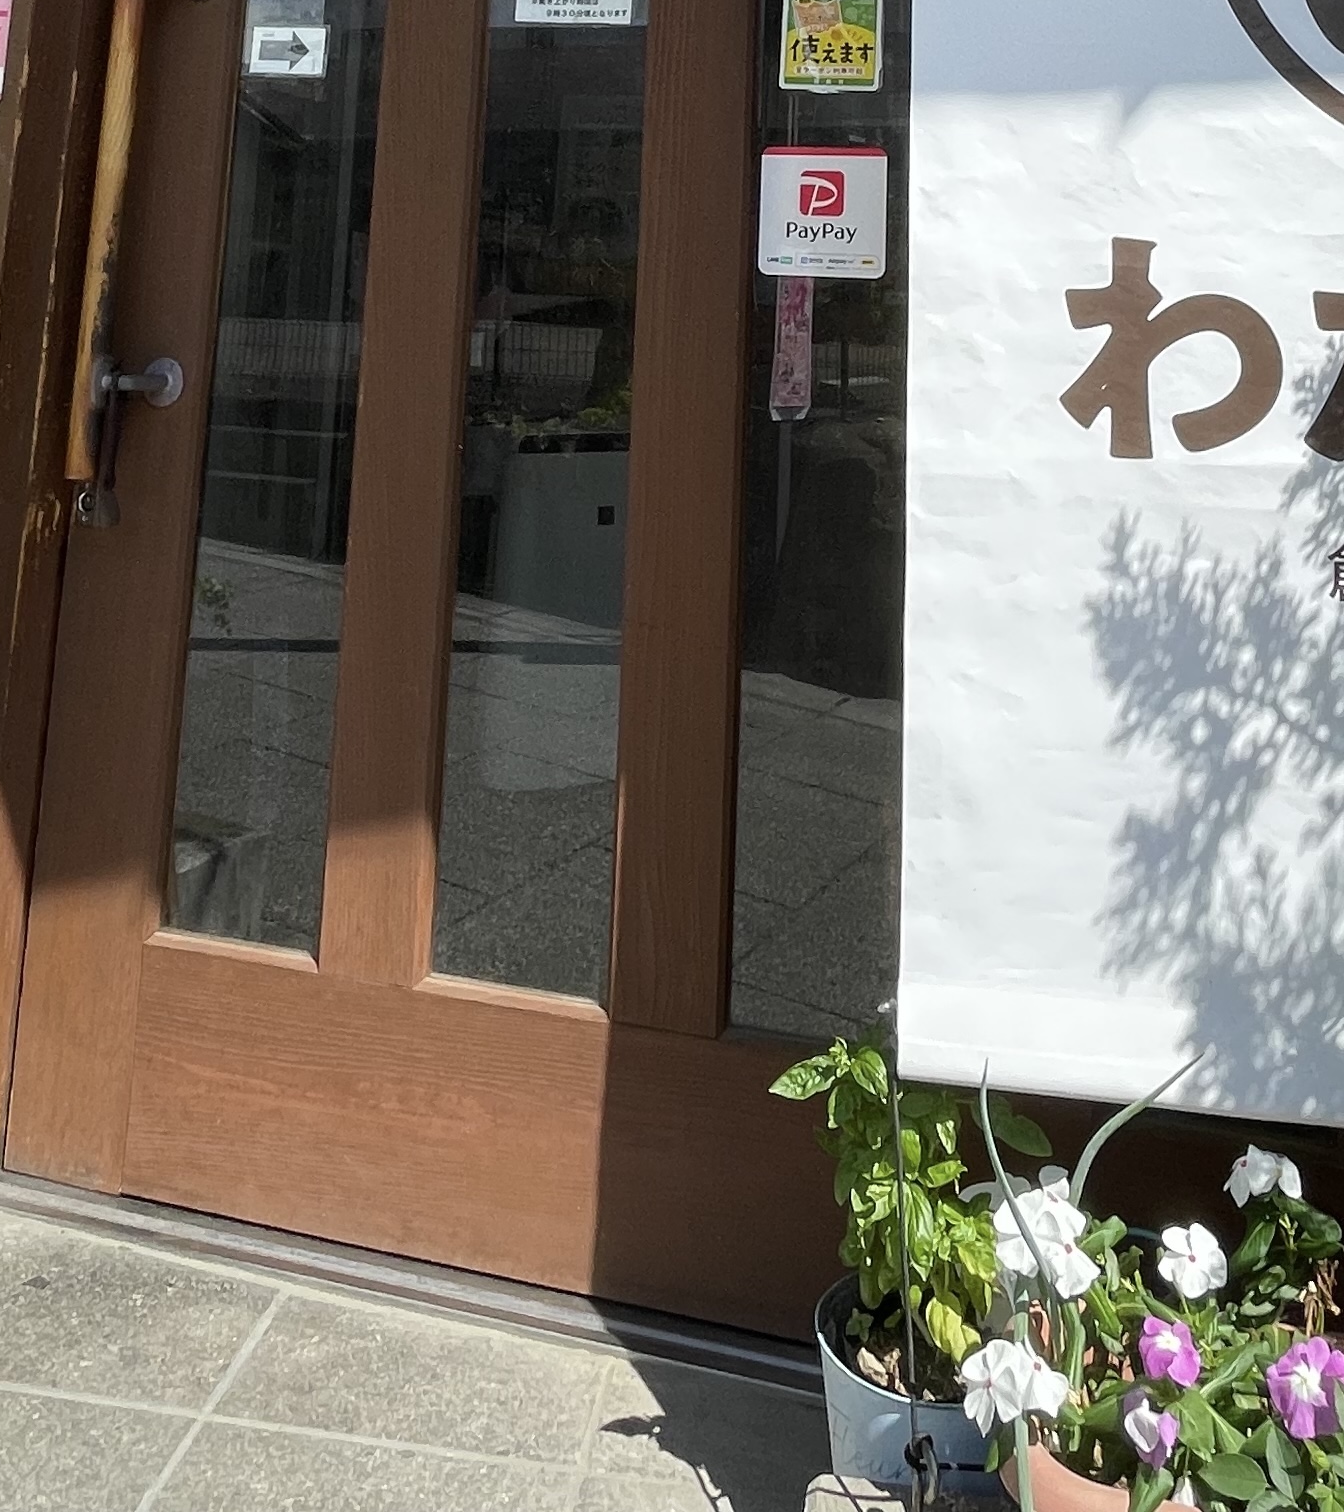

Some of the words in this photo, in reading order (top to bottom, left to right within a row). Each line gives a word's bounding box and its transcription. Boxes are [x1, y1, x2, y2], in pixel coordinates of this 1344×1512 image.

[789, 34, 874, 65] 使えます
[785, 221, 858, 244] PayPay
